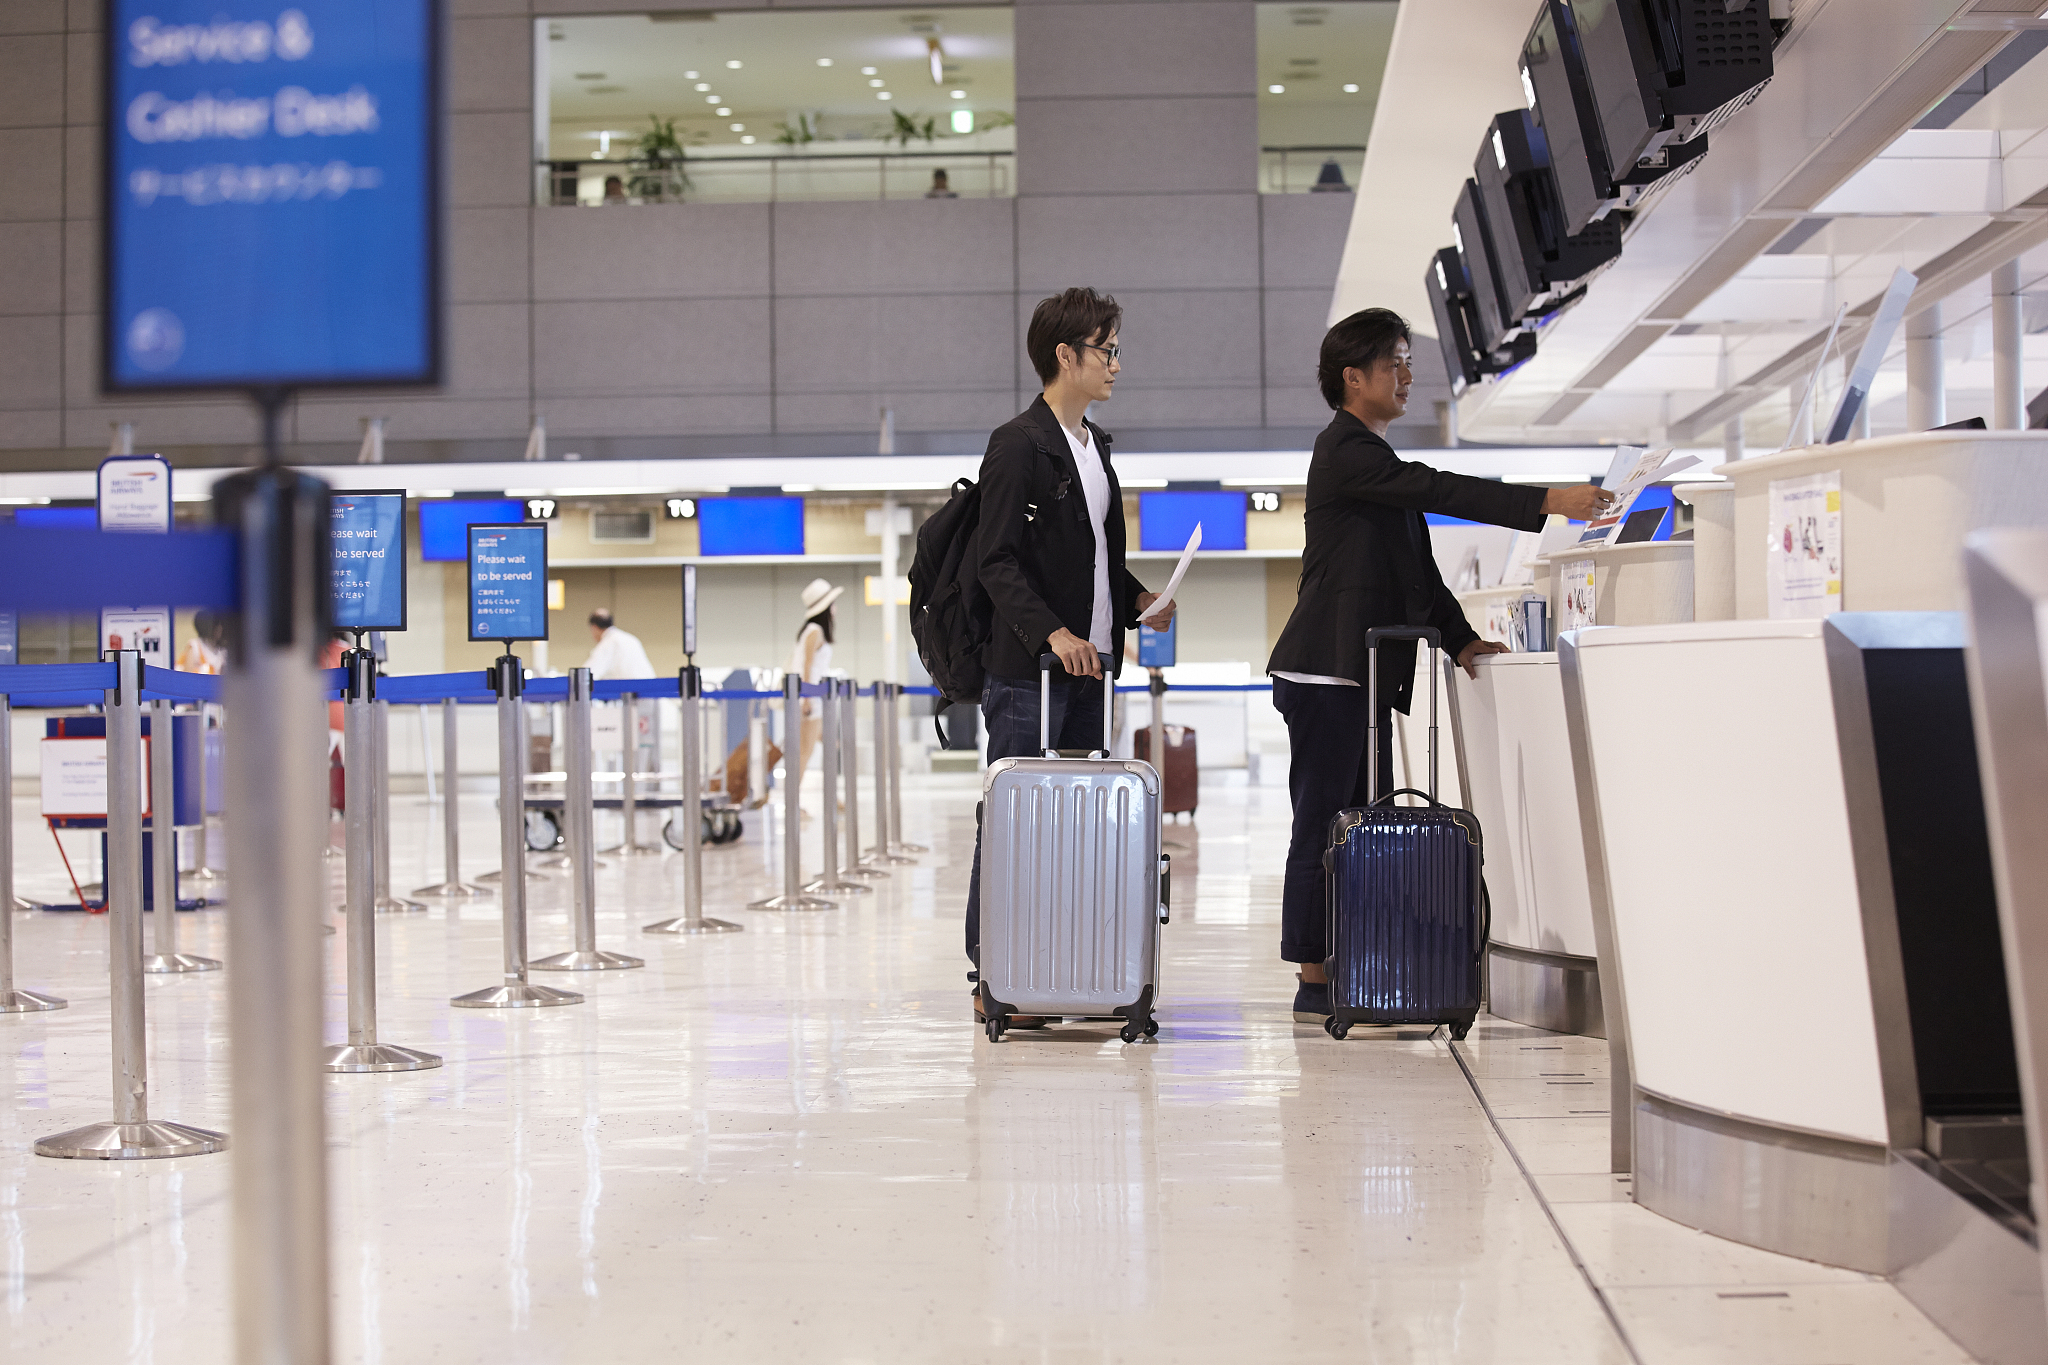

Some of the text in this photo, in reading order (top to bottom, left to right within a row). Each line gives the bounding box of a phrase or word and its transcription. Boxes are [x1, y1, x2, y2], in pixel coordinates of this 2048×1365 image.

[128, 8, 314, 67] Service &
[126, 85, 380, 143] Cashier Desk
[527, 499, 556, 518] T7
[356, 528, 378, 538] wait
[335, 548, 348, 558] be
[350, 548, 385, 558] served
[477, 555, 526, 564] Please wait
[477, 571, 533, 581] to be served
